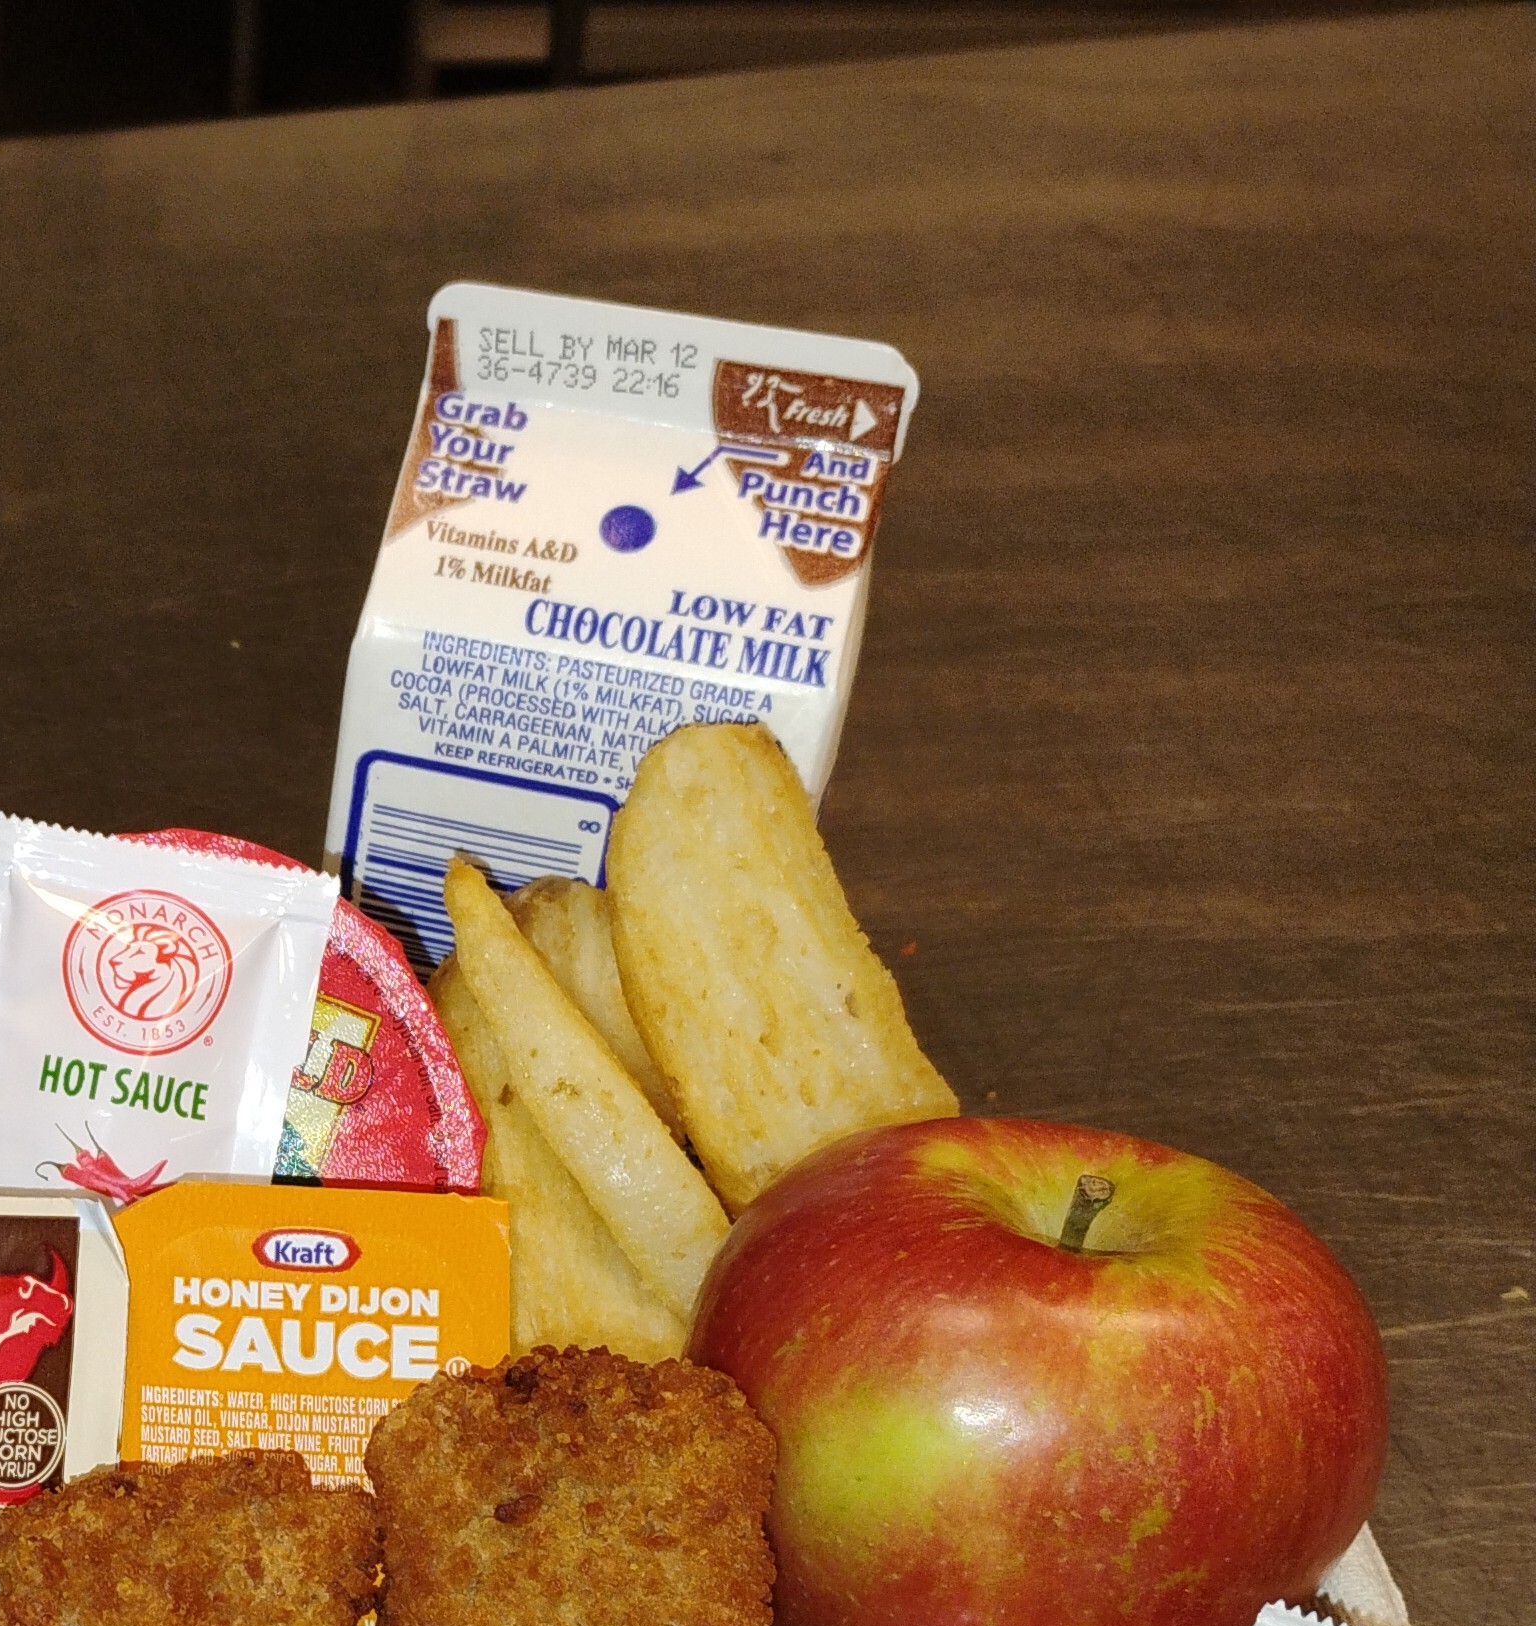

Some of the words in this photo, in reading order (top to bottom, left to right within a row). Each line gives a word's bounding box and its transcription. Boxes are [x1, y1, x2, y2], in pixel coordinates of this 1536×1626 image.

[477, 328, 544, 359] SELL
[561, 335, 595, 361] BY
[606, 337, 658, 368] MAR
[669, 344, 698, 369] 12
[476, 355, 598, 390] 36-4739
[434, 392, 529, 432] Grab
[782, 399, 850, 428] Fresh
[428, 424, 516, 464] Your
[413, 460, 528, 504] Straw
[804, 451, 872, 481] And
[737, 472, 862, 518] Punch
[426, 519, 519, 555] Vitamins
[524, 532, 578, 564] A&D
[758, 511, 856, 554] Here
[433, 554, 466, 581] 1%
[471, 560, 554, 594] Milkfat
[670, 590, 757, 628] LOW
[764, 607, 834, 642] FAT
[524, 598, 731, 671] CHOCOLATE
[735, 639, 831, 688] MILK
[421, 652, 498, 683] LOWFAT
[500, 670, 547, 695] MILK
[423, 631, 552, 672] INGREDIENTS:
[557, 656, 685, 697] PASTEURIZED
[689, 682, 754, 710] GRADE
[390, 668, 453, 698] COCOA
[457, 682, 578, 719] (PROCESSED
[581, 704, 631, 730] WITH
[397, 692, 447, 721] SALT,
[418, 717, 496, 746] VITAMIN
[516, 734, 625, 773] PALMITATE,
[433, 740, 475, 762] KEEP
[475, 749, 599, 786] REFRIGERATED
[82, 901, 221, 963] MONARCH
[138, 1017, 189, 1042] 1853
[38, 1053, 107, 1101] HOT
[109, 1066, 211, 1122] SAUCE
[273, 1240, 336, 1266] Kraft
[173, 1276, 312, 1312] HONEY
[320, 1284, 440, 1318] DIJON
[171, 1313, 441, 1381] SAUCE
[4, 1393, 30, 1411] NO
[140, 1385, 224, 1408] INGREDIENTS:
[227, 1390, 269, 1412] WATER,
[270, 1392, 297, 1412] HIGH
[299, 1394, 357, 1416] FRUCTOSE
[358, 1397, 389, 1416] CORN
[140, 1406, 193, 1427] SOYBEAN
[219, 1411, 274, 1432] VINEGAR,
[275, 1413, 310, 1432] DIJON
[312, 1414, 364, 1435] MUSTARD
[140, 1427, 192, 1447] MUSTARD
[258, 1432, 293, 1451] WHITE
[327, 1434, 360, 1454] FRUIT
